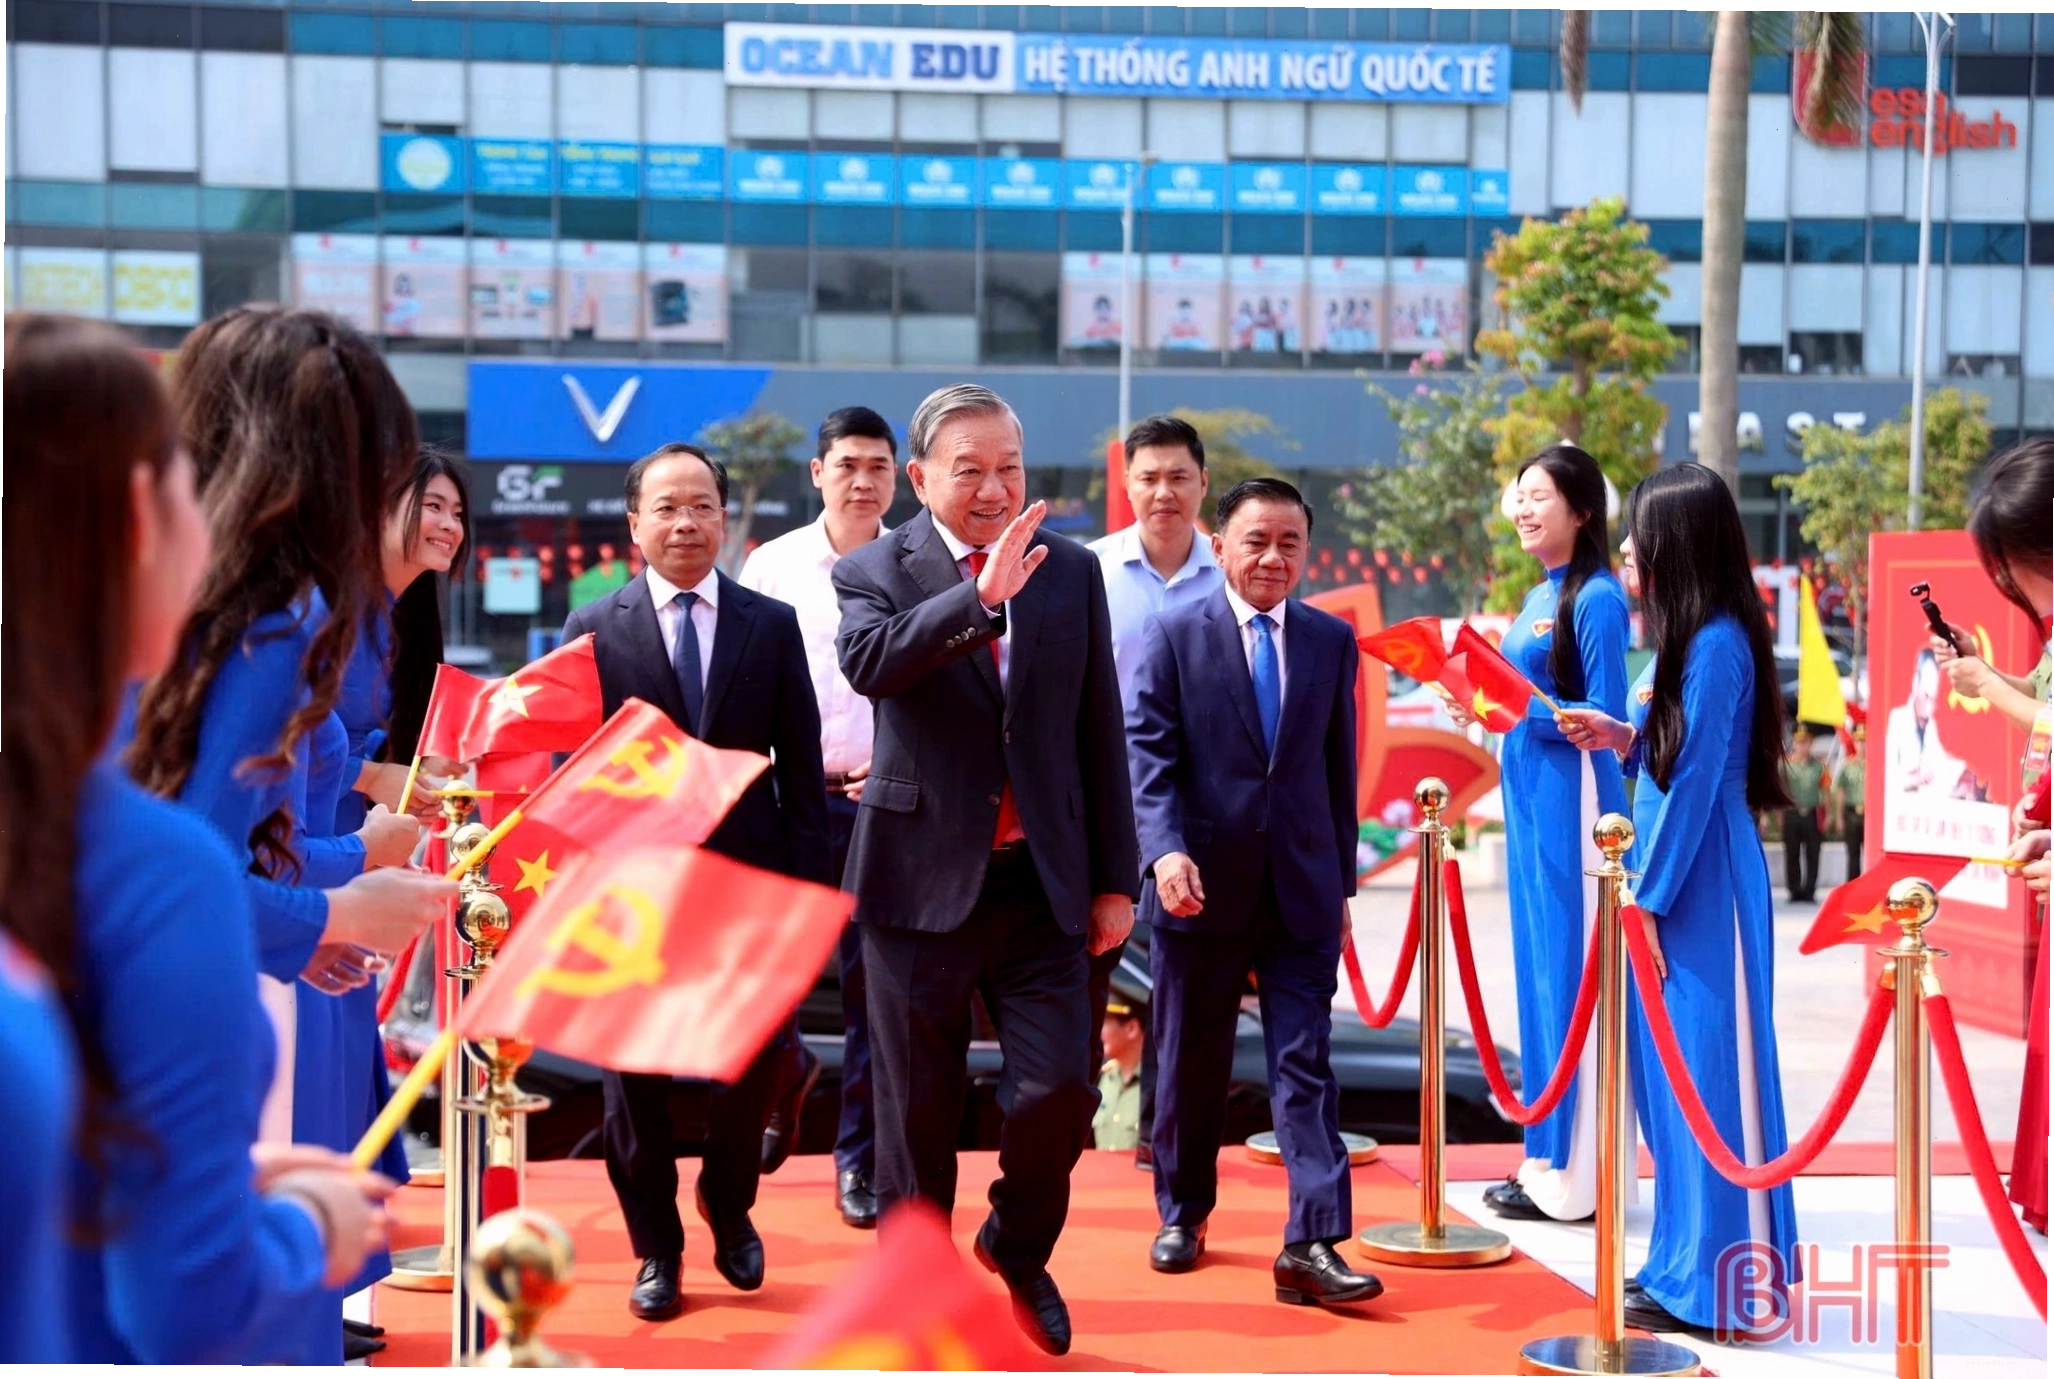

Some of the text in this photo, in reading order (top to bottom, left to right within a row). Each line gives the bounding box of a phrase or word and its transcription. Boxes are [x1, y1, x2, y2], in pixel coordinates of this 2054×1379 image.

[740, 37, 999, 80] OCEAN EDU
[1024, 36, 1499, 94] HỆ THỐNG ANH NGỮ QUỐC TẾ
[1870, 109, 2017, 157] english
